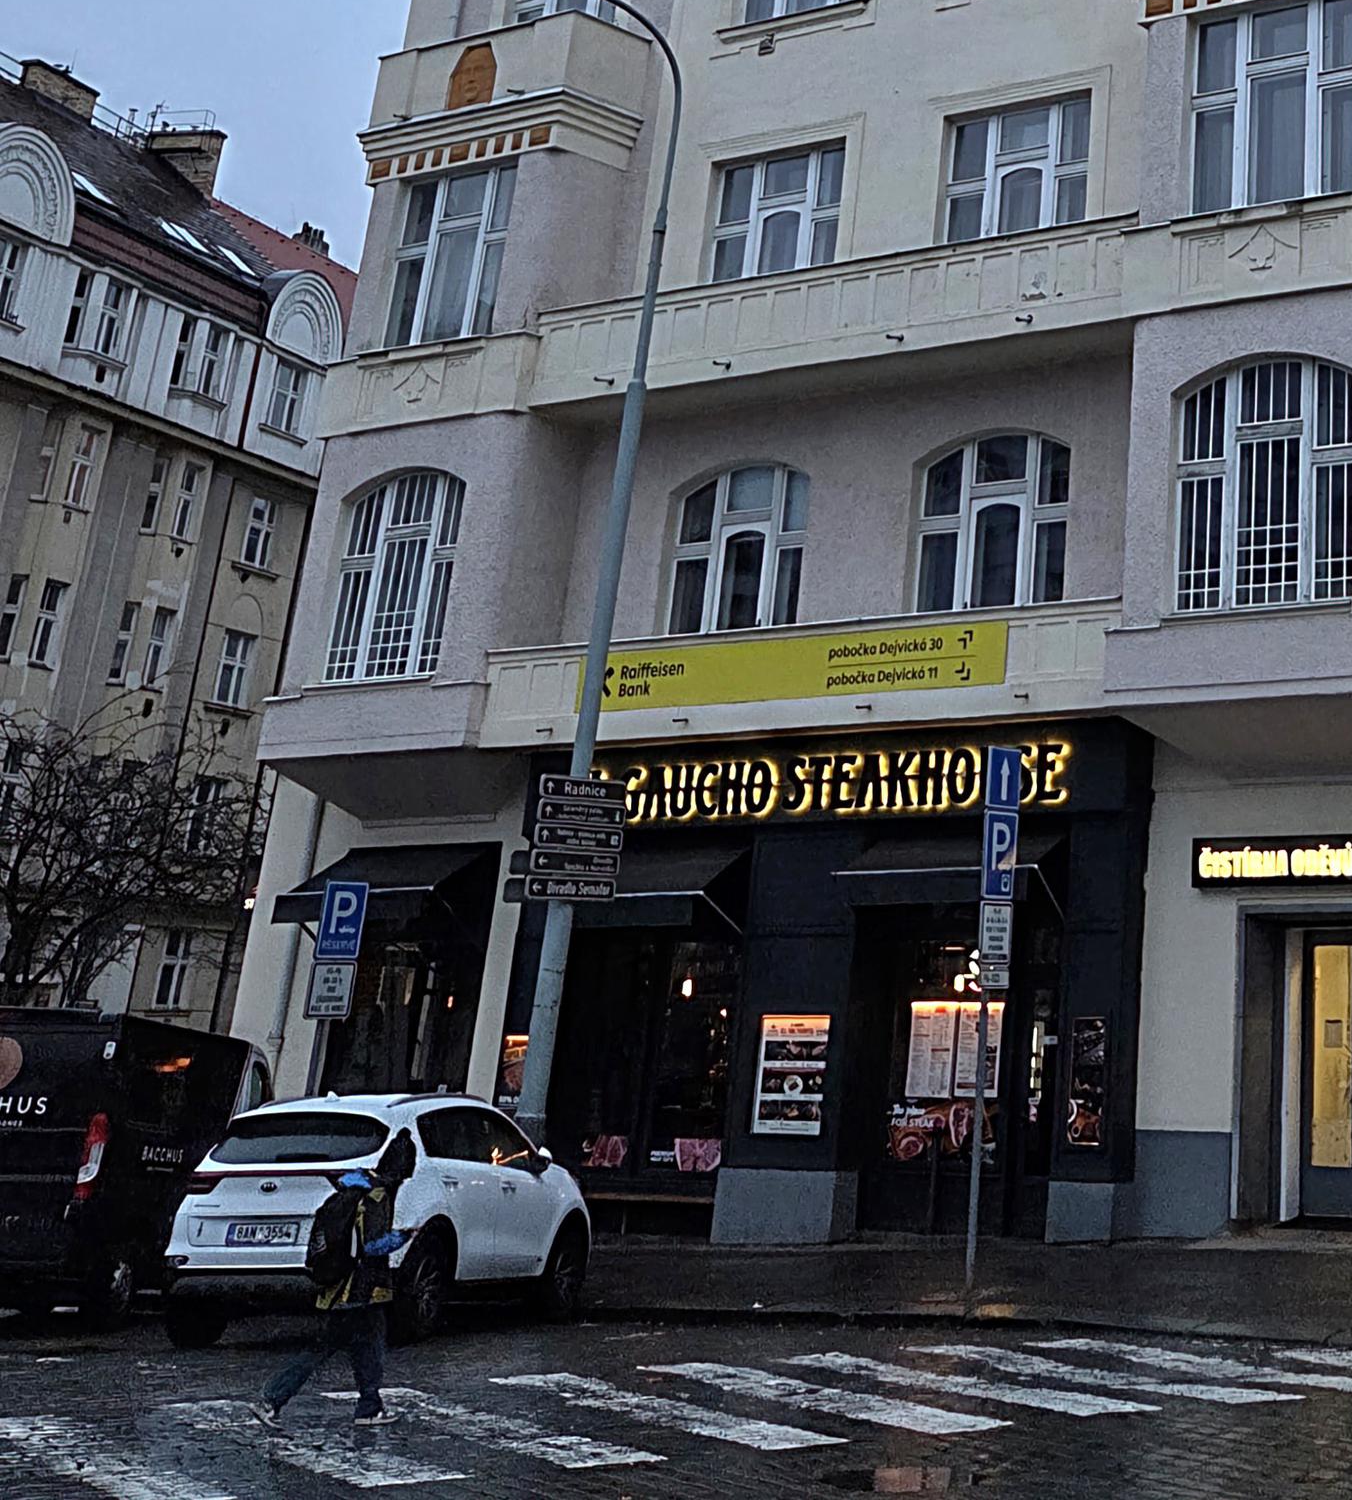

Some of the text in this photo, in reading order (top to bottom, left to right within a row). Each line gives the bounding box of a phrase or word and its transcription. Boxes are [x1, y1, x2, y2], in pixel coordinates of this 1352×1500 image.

[828, 637, 943, 662] pobočka Dejvická 30
[620, 661, 685, 681] Raiffeisen
[826, 667, 938, 689] pobočka Dejvická 11
[618, 680, 651, 697] Bank
[564, 781, 607, 797] Radnice
[624, 743, 1065, 820] GAUCHO STEAKHOSE
[991, 822, 1011, 871] P
[1198, 846, 1289, 879] ČISTÍRNA
[329, 891, 358, 934] P
[141, 1146, 184, 1163] BACCHUS
